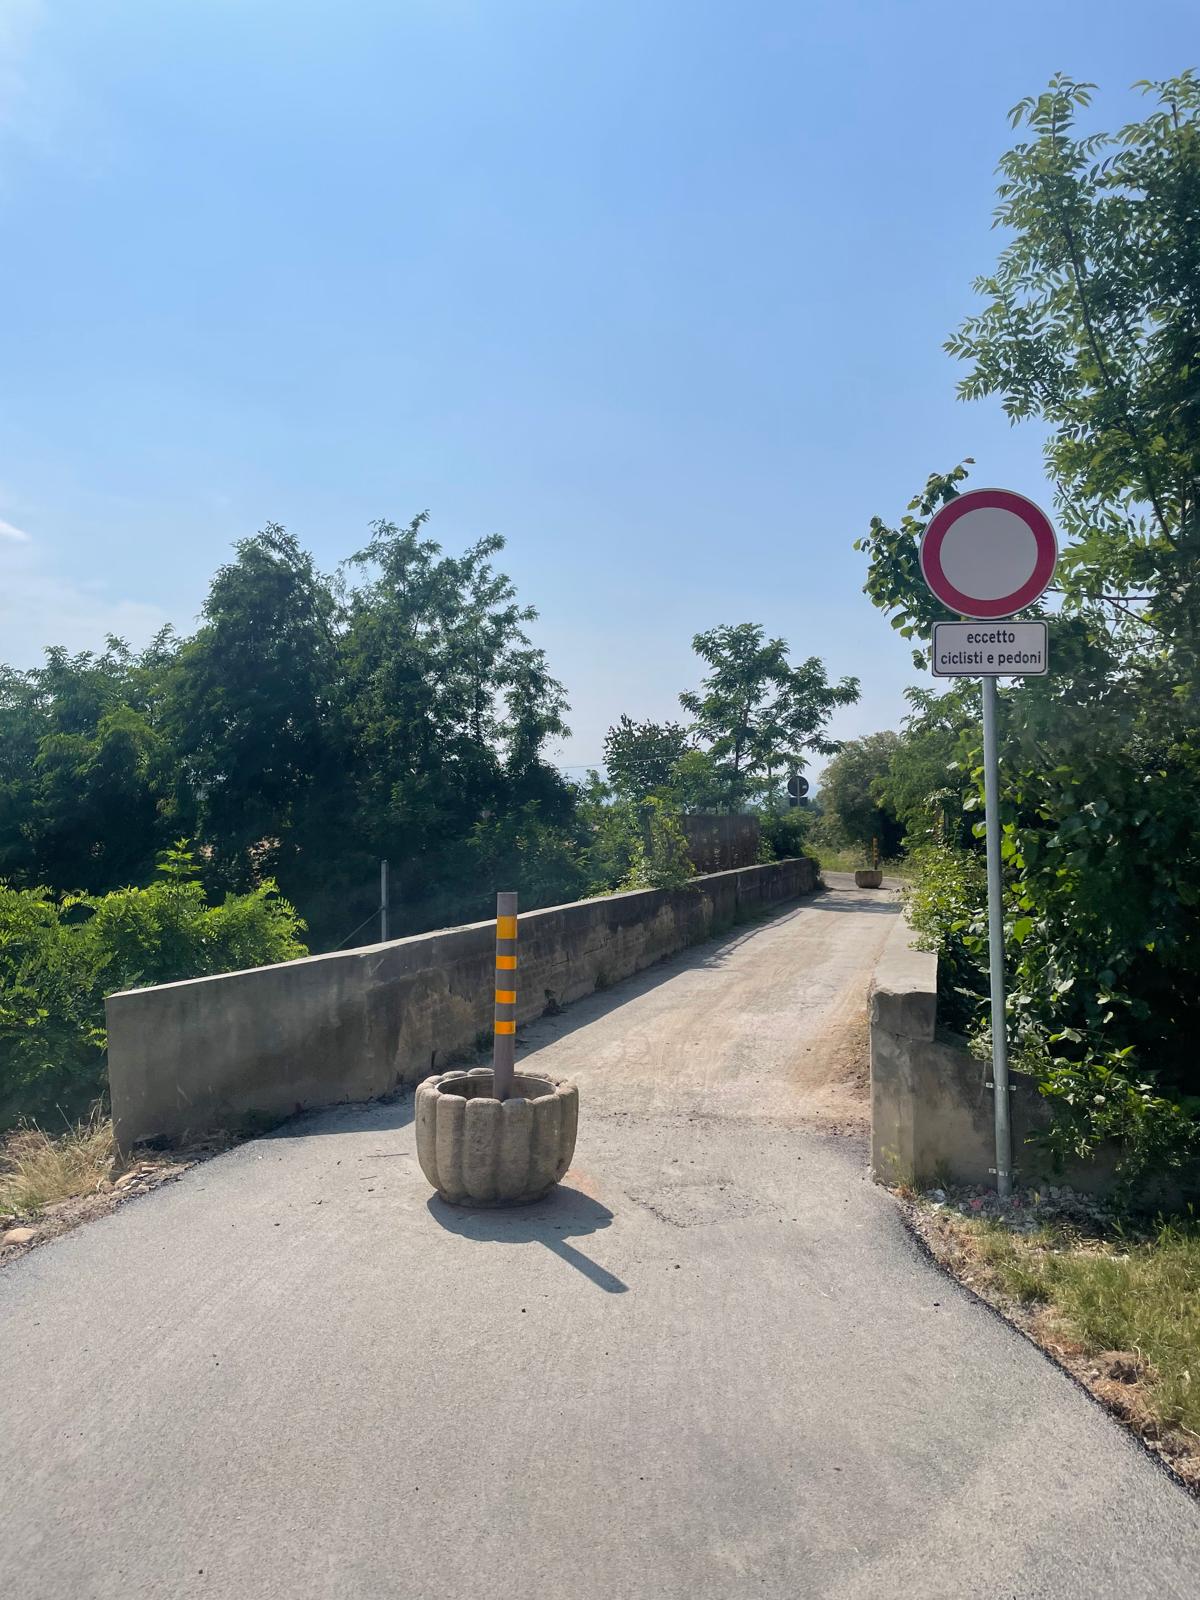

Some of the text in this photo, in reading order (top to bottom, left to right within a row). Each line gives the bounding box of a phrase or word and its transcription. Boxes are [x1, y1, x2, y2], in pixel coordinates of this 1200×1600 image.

[967, 630, 1015, 644] eccetto
[941, 651, 1041, 666] ciclisti e pedoni
